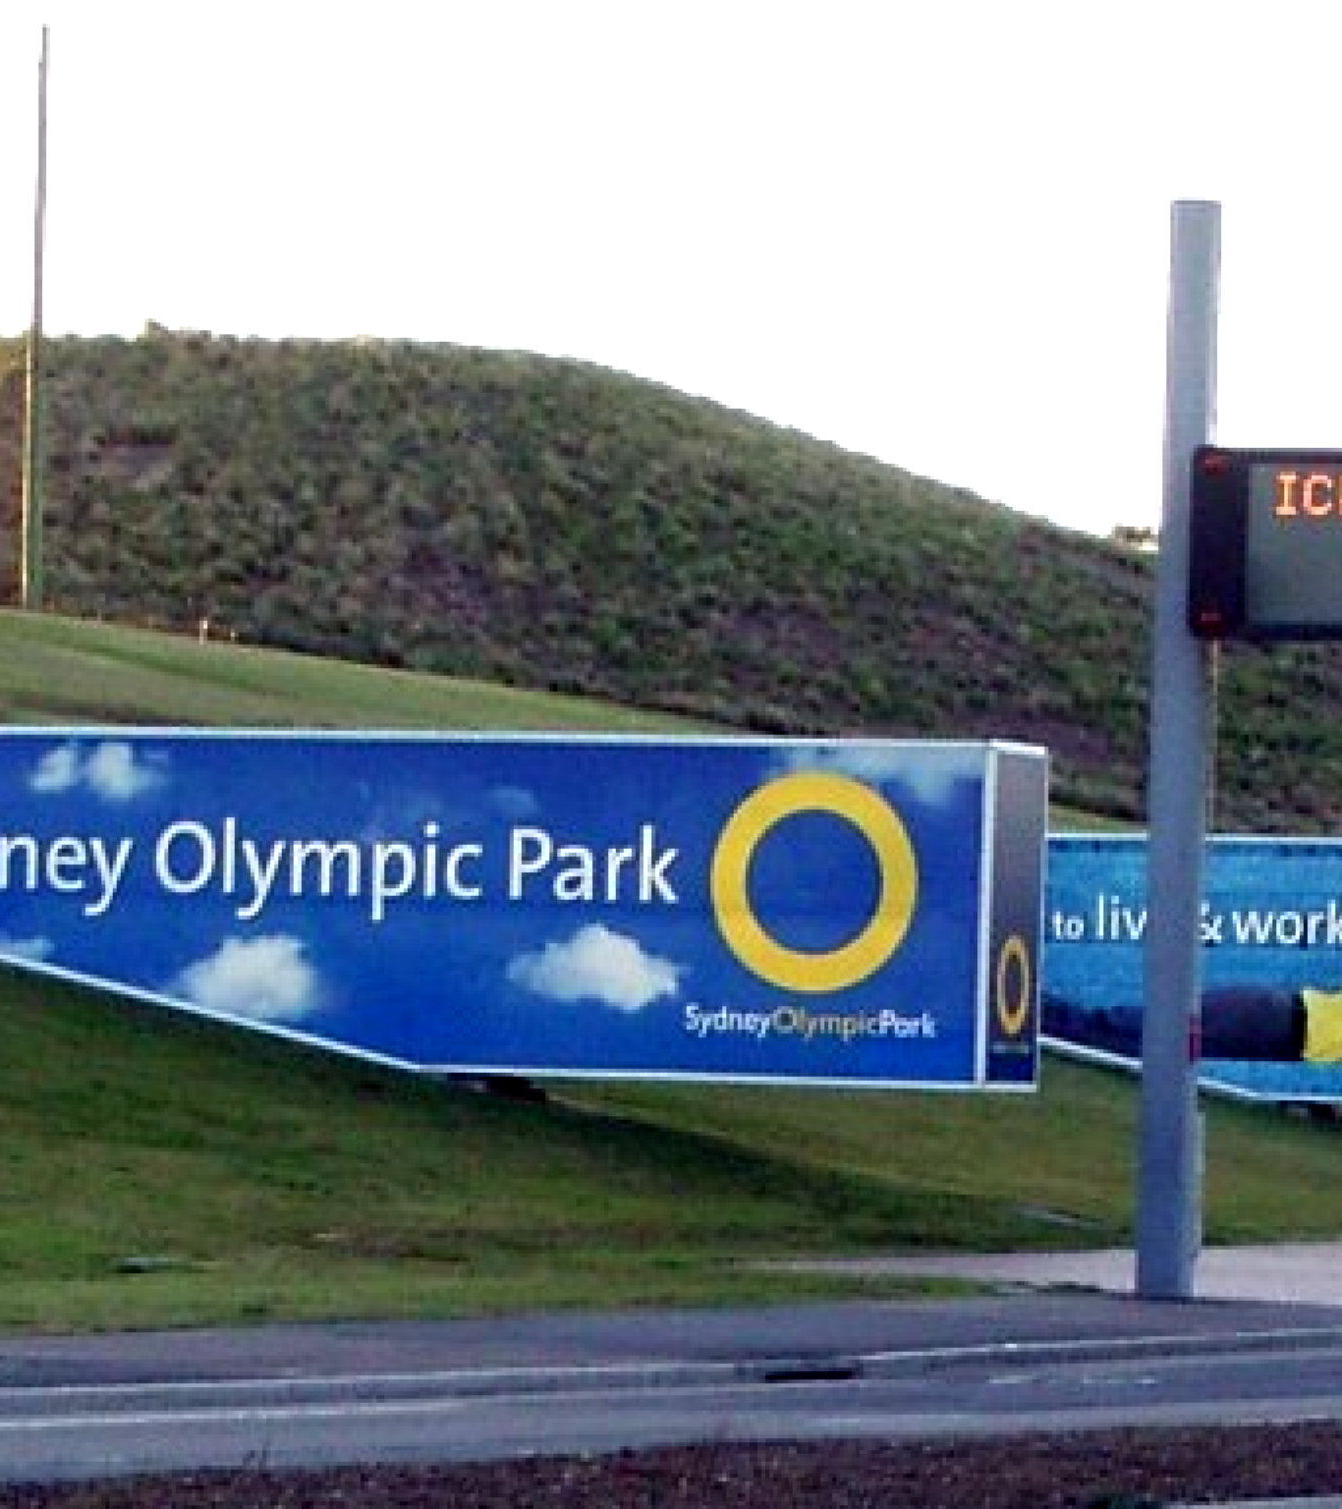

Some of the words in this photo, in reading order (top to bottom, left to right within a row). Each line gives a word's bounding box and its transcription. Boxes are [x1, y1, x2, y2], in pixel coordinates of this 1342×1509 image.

[155, 816, 484, 920] Olympic
[508, 824, 681, 906] Park
[1052, 910, 1084, 940] to
[1095, 892, 1148, 941] liv
